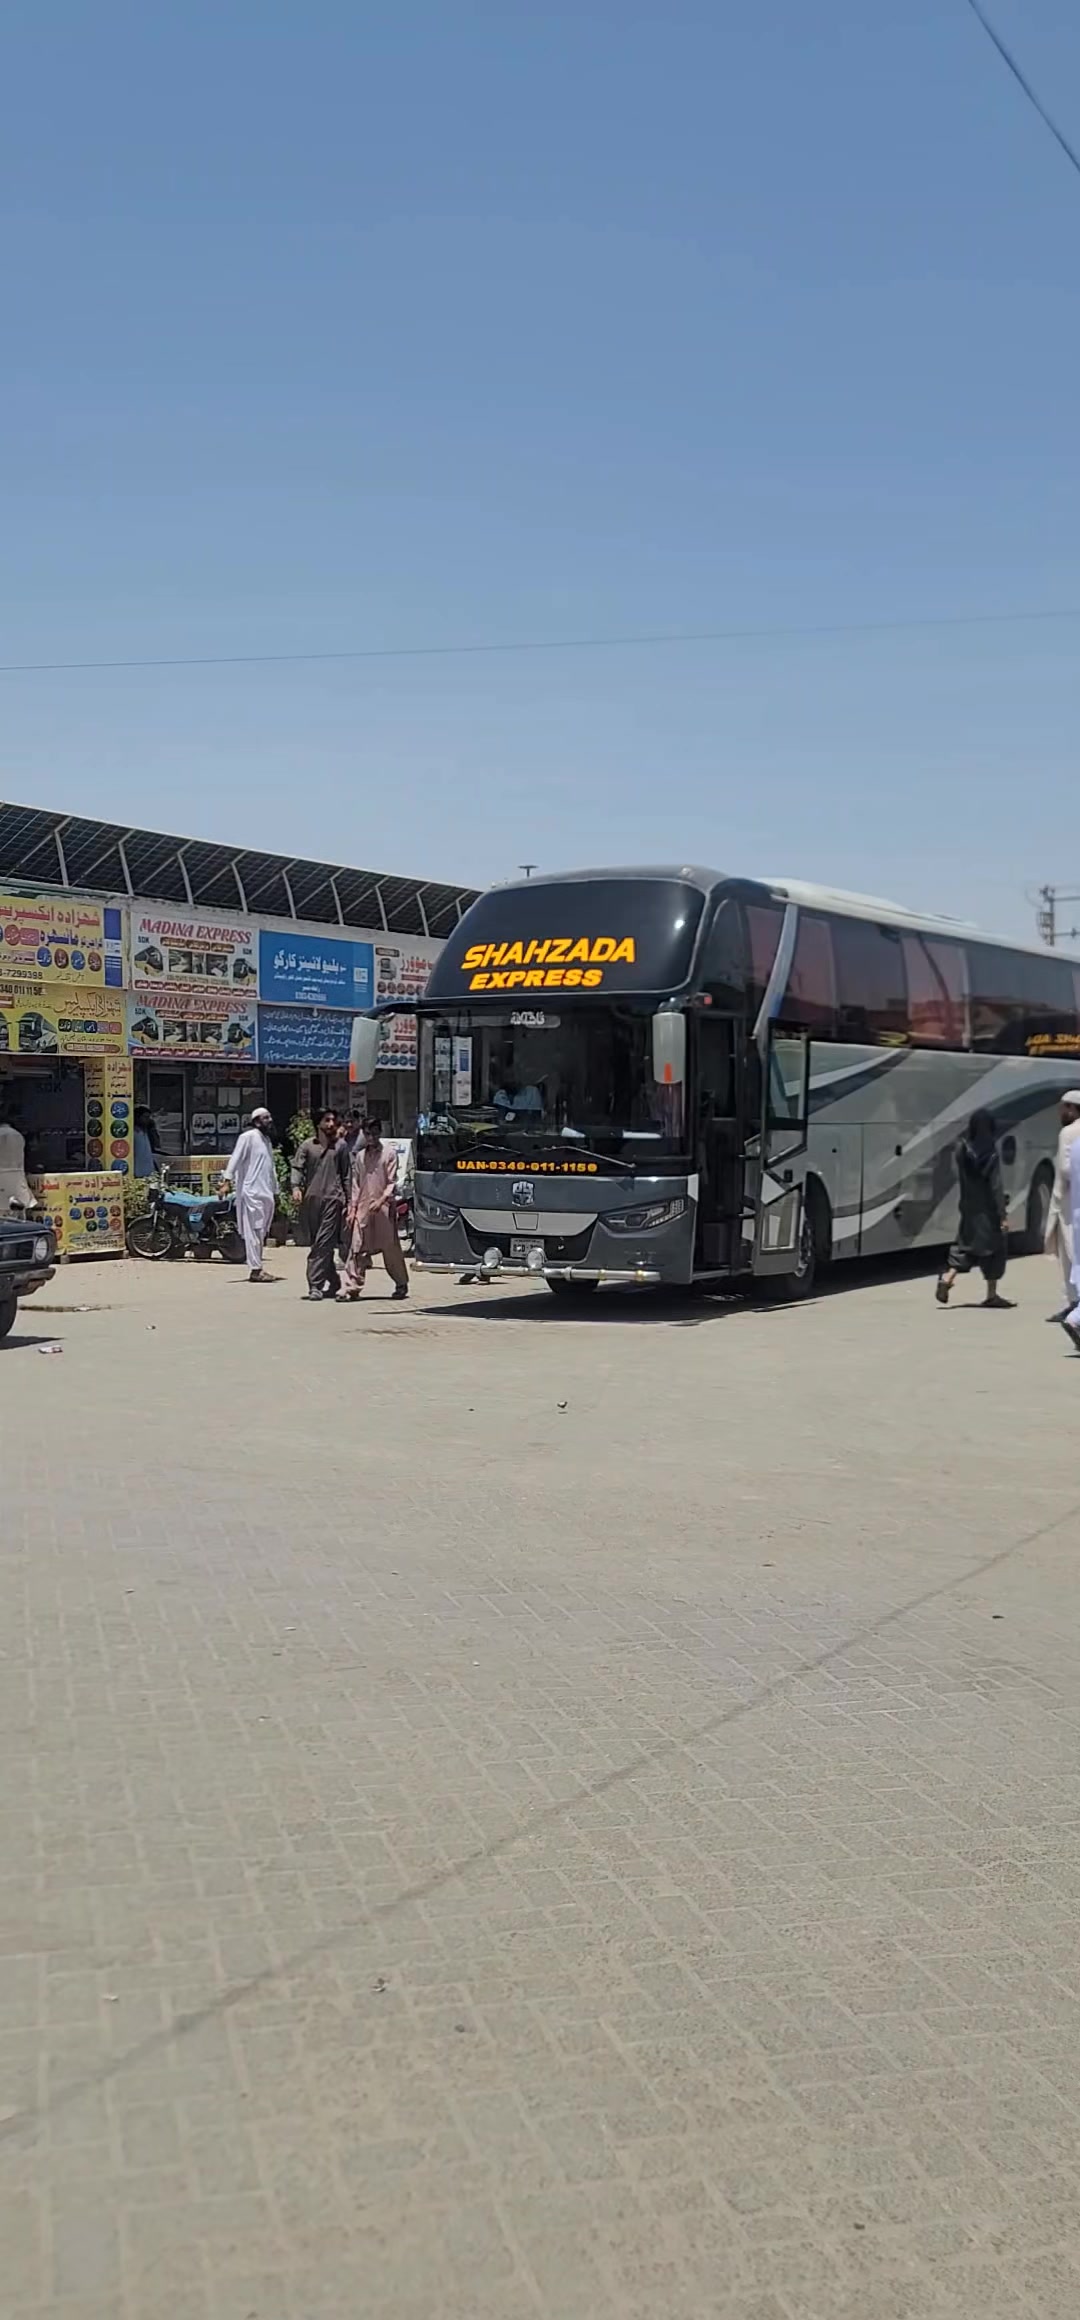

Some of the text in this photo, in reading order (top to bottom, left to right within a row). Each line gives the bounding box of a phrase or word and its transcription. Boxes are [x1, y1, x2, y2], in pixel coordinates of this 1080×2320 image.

[139, 918, 194, 938] MADINA
[196, 925, 253, 945] EXPRESS
[460, 937, 636, 969] SHAHZADA
[468, 968, 603, 991] EXPRESS
[190, 1000, 248, 1014] EXPRESS
[456, 1160, 598, 1173] UAN-0340-011-1150
